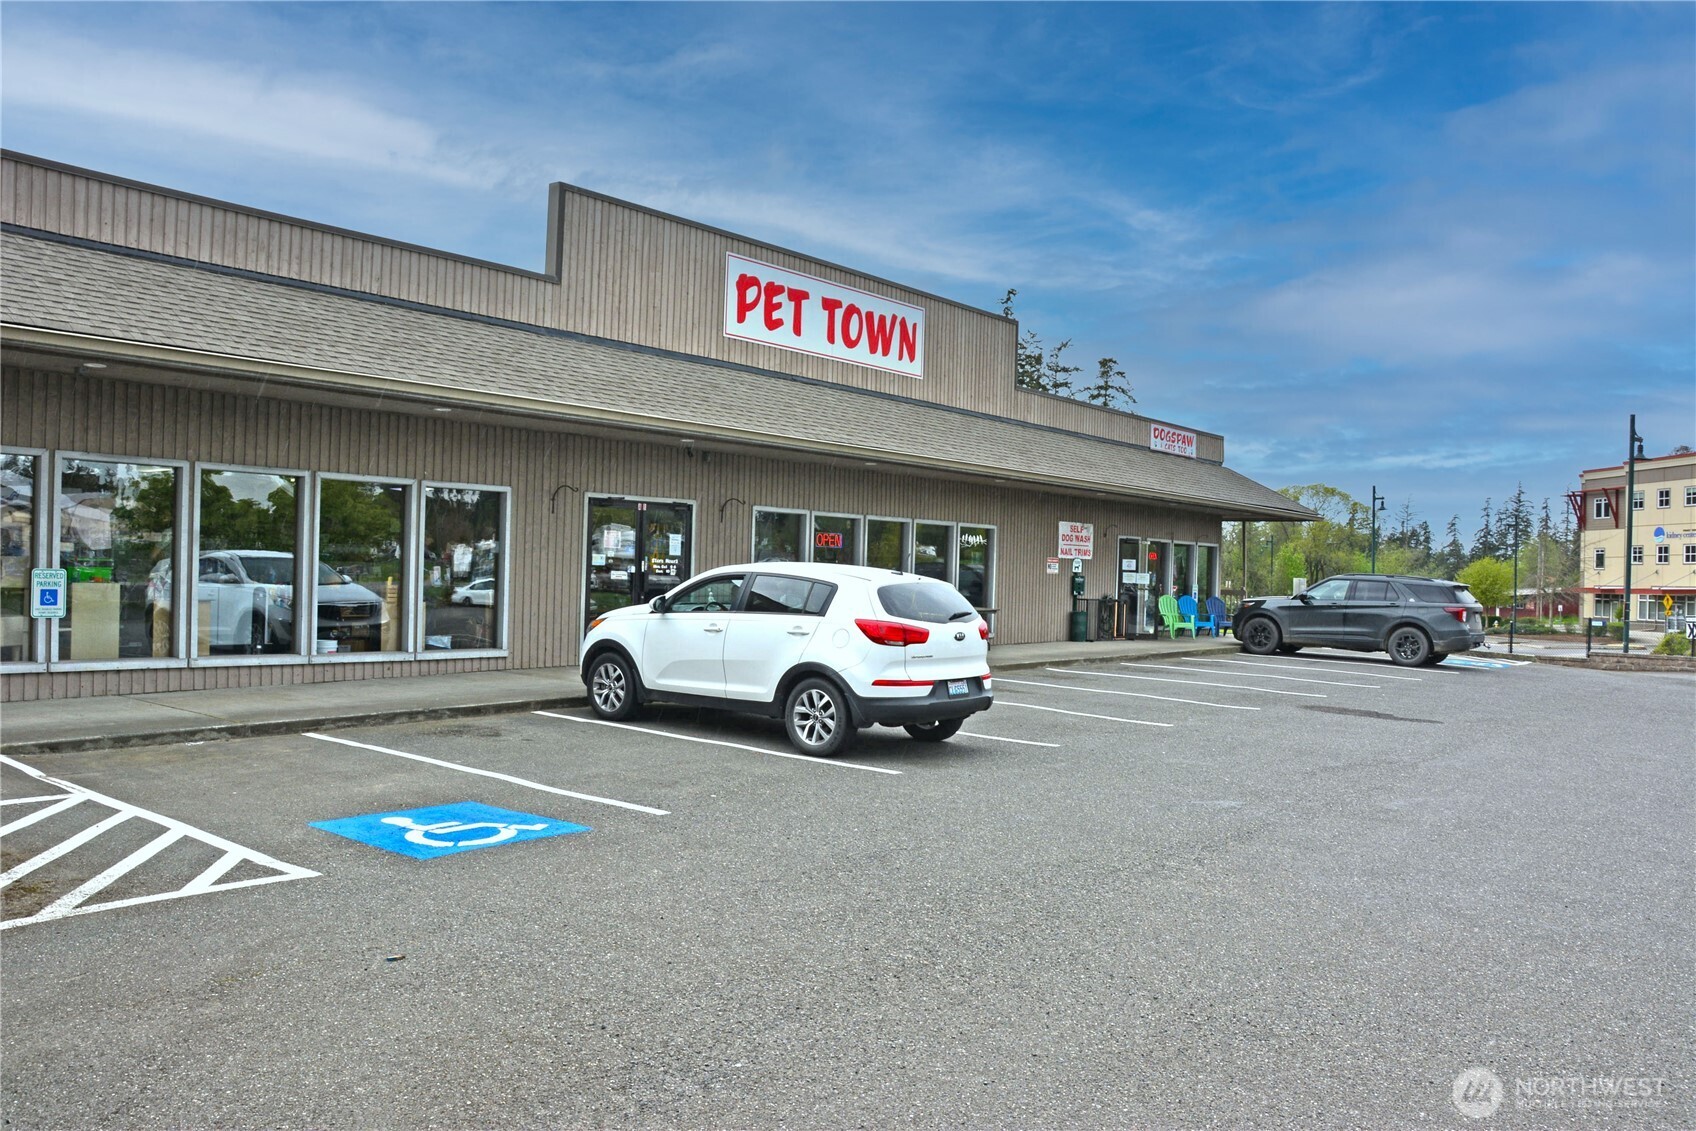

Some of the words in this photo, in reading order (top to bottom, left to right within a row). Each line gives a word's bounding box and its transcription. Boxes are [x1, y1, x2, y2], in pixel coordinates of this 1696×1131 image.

[735, 273, 810, 337] PET
[821, 296, 917, 363] TOWN
[1153, 427, 1194, 447] DOGSPAW
[1070, 525, 1084, 533] SELF
[816, 533, 842, 547] OPEN
[1061, 534, 1073, 542] DOG
[1075, 535, 1091, 543] WASH
[1060, 548, 1073, 556] NAIL
[1074, 548, 1091, 557] TRIMS
